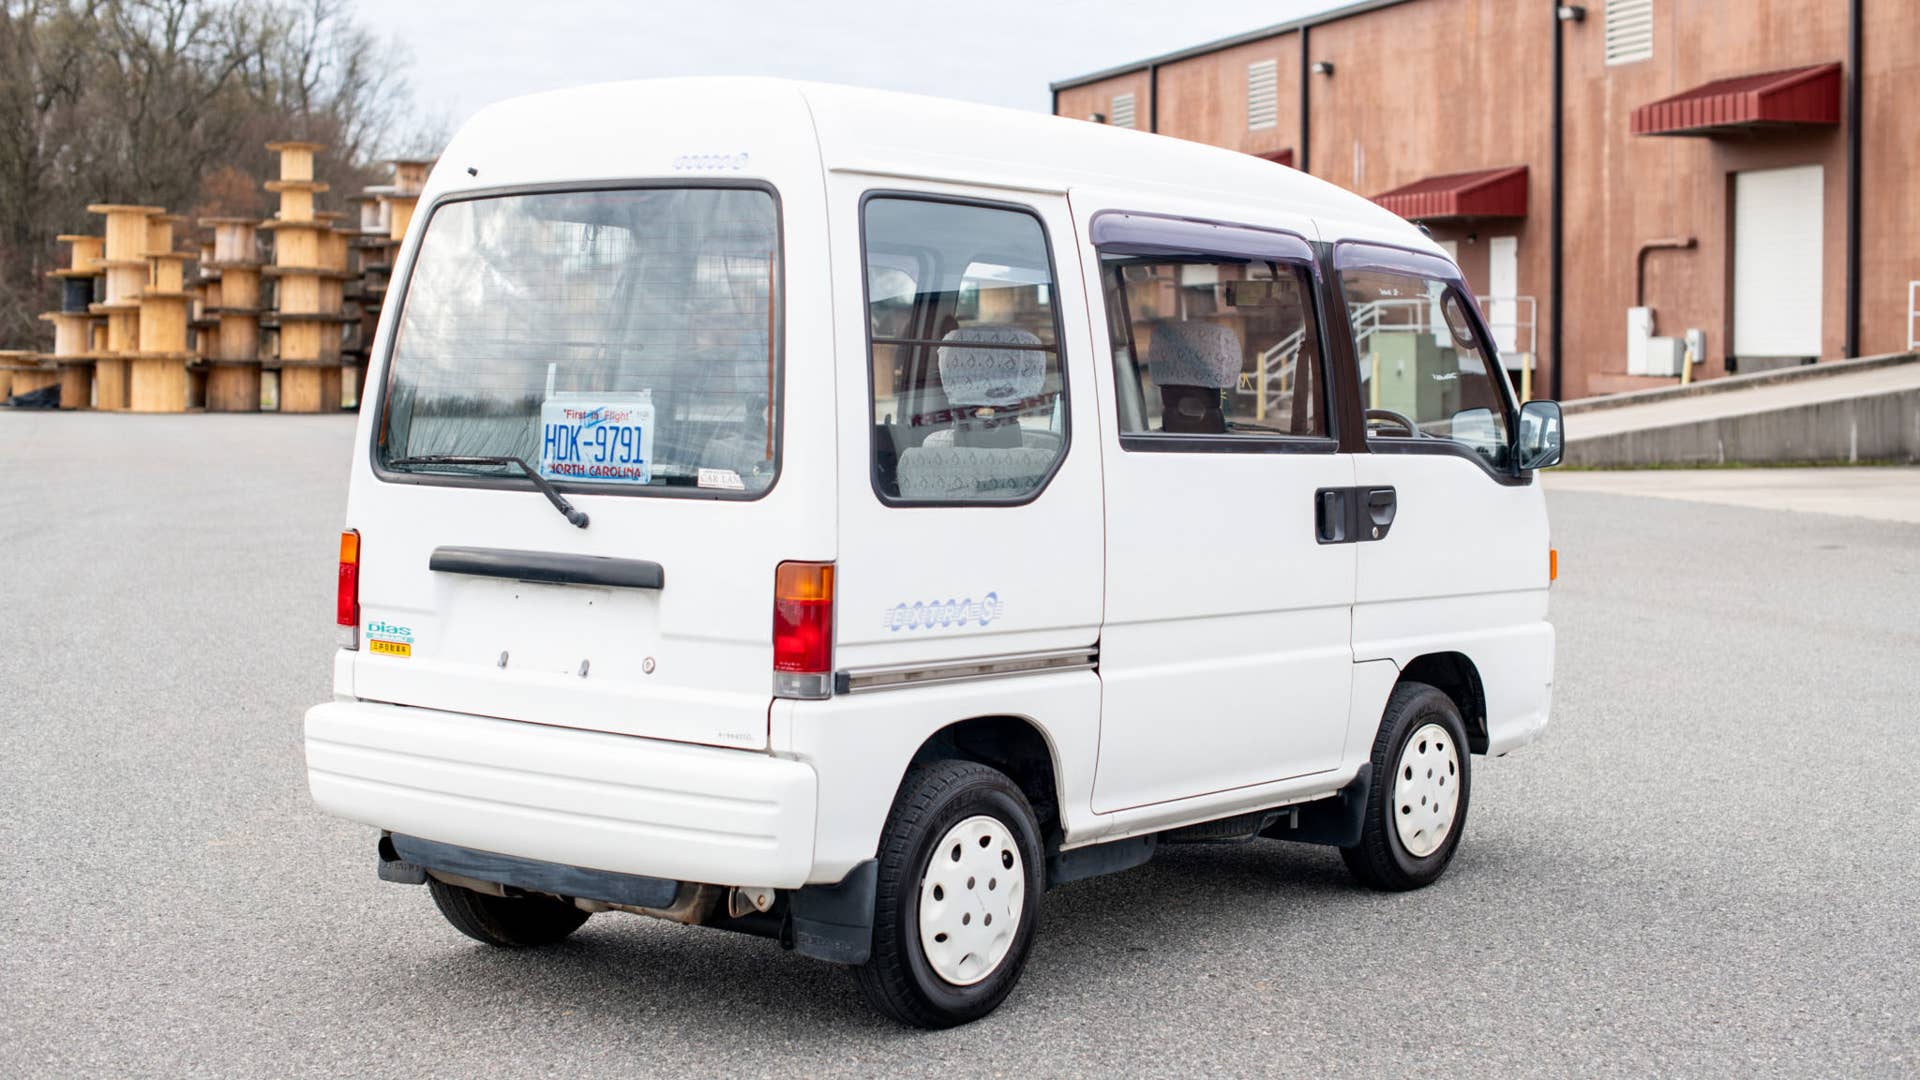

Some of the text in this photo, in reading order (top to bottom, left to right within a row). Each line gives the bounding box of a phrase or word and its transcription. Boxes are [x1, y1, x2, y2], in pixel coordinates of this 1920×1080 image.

[543, 423, 644, 464] HDK-9791
[548, 463, 641, 480] NORTH CAROLINA
